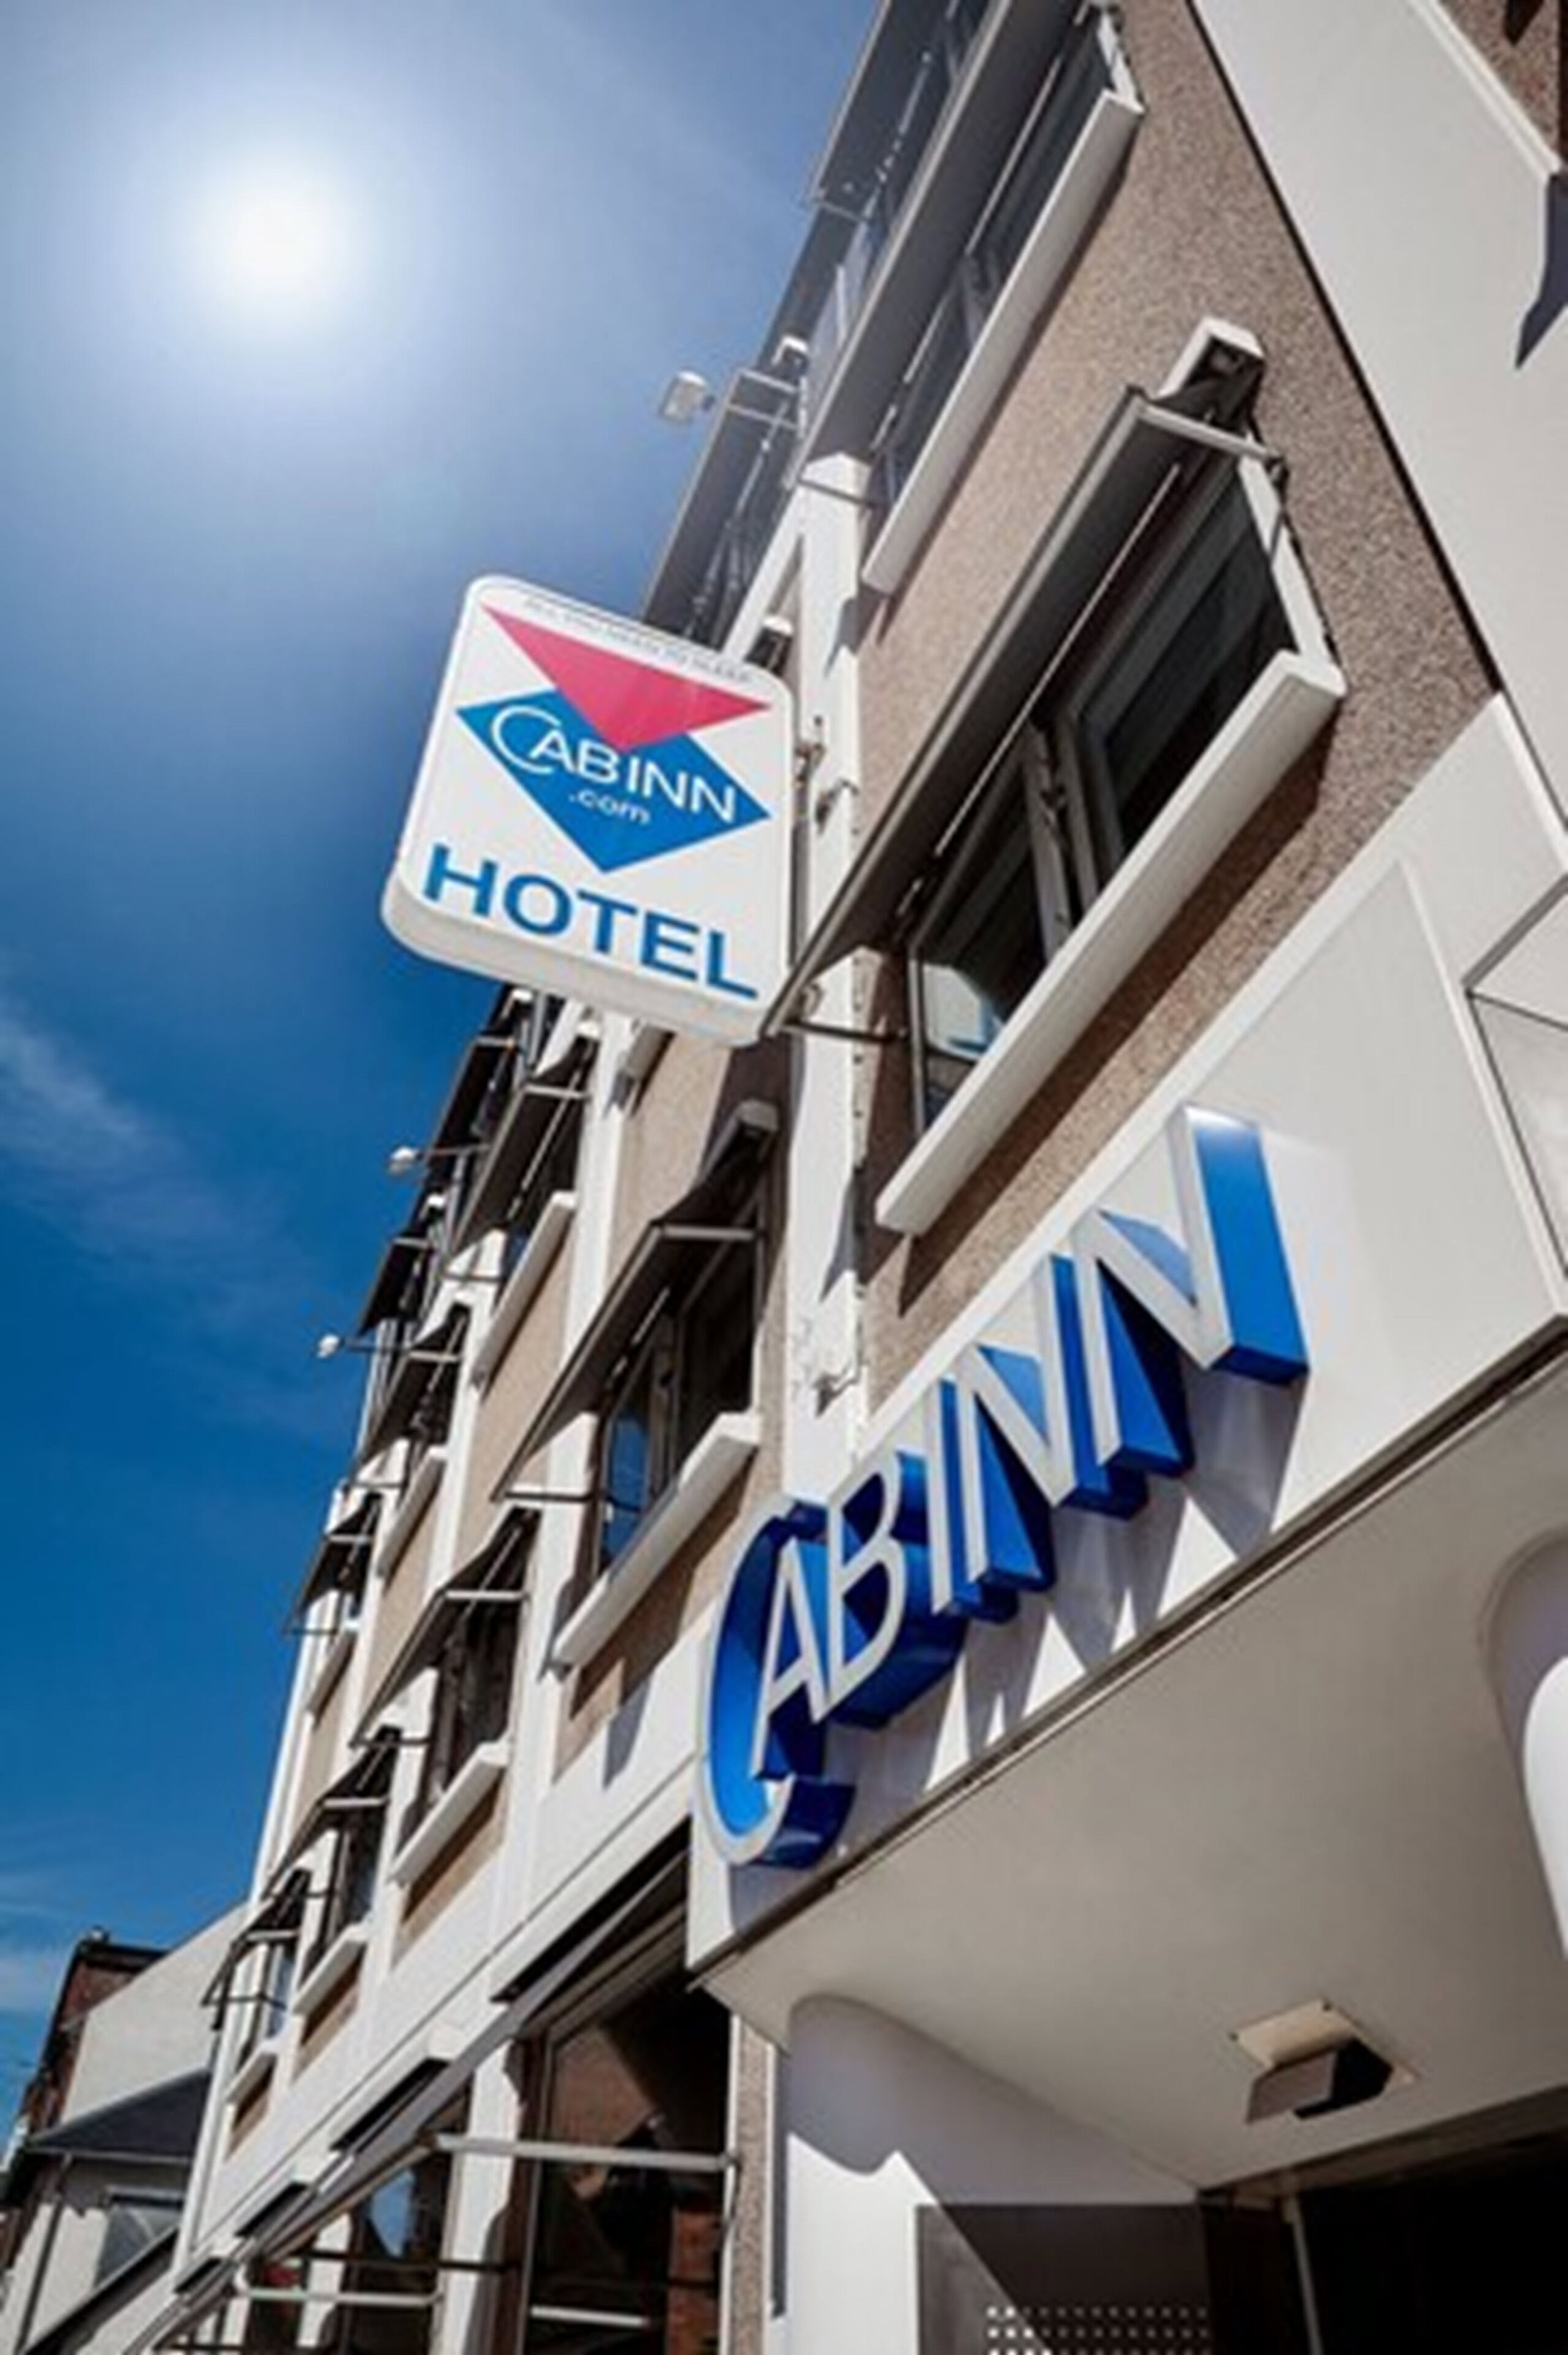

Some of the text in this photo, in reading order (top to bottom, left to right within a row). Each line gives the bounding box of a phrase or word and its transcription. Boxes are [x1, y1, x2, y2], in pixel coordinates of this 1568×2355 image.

[492, 704, 737, 823] CABINN
[568, 788, 651, 825] .com
[421, 842, 759, 1000] HOTEL
[696, 1104, 1309, 1868] CABINN
